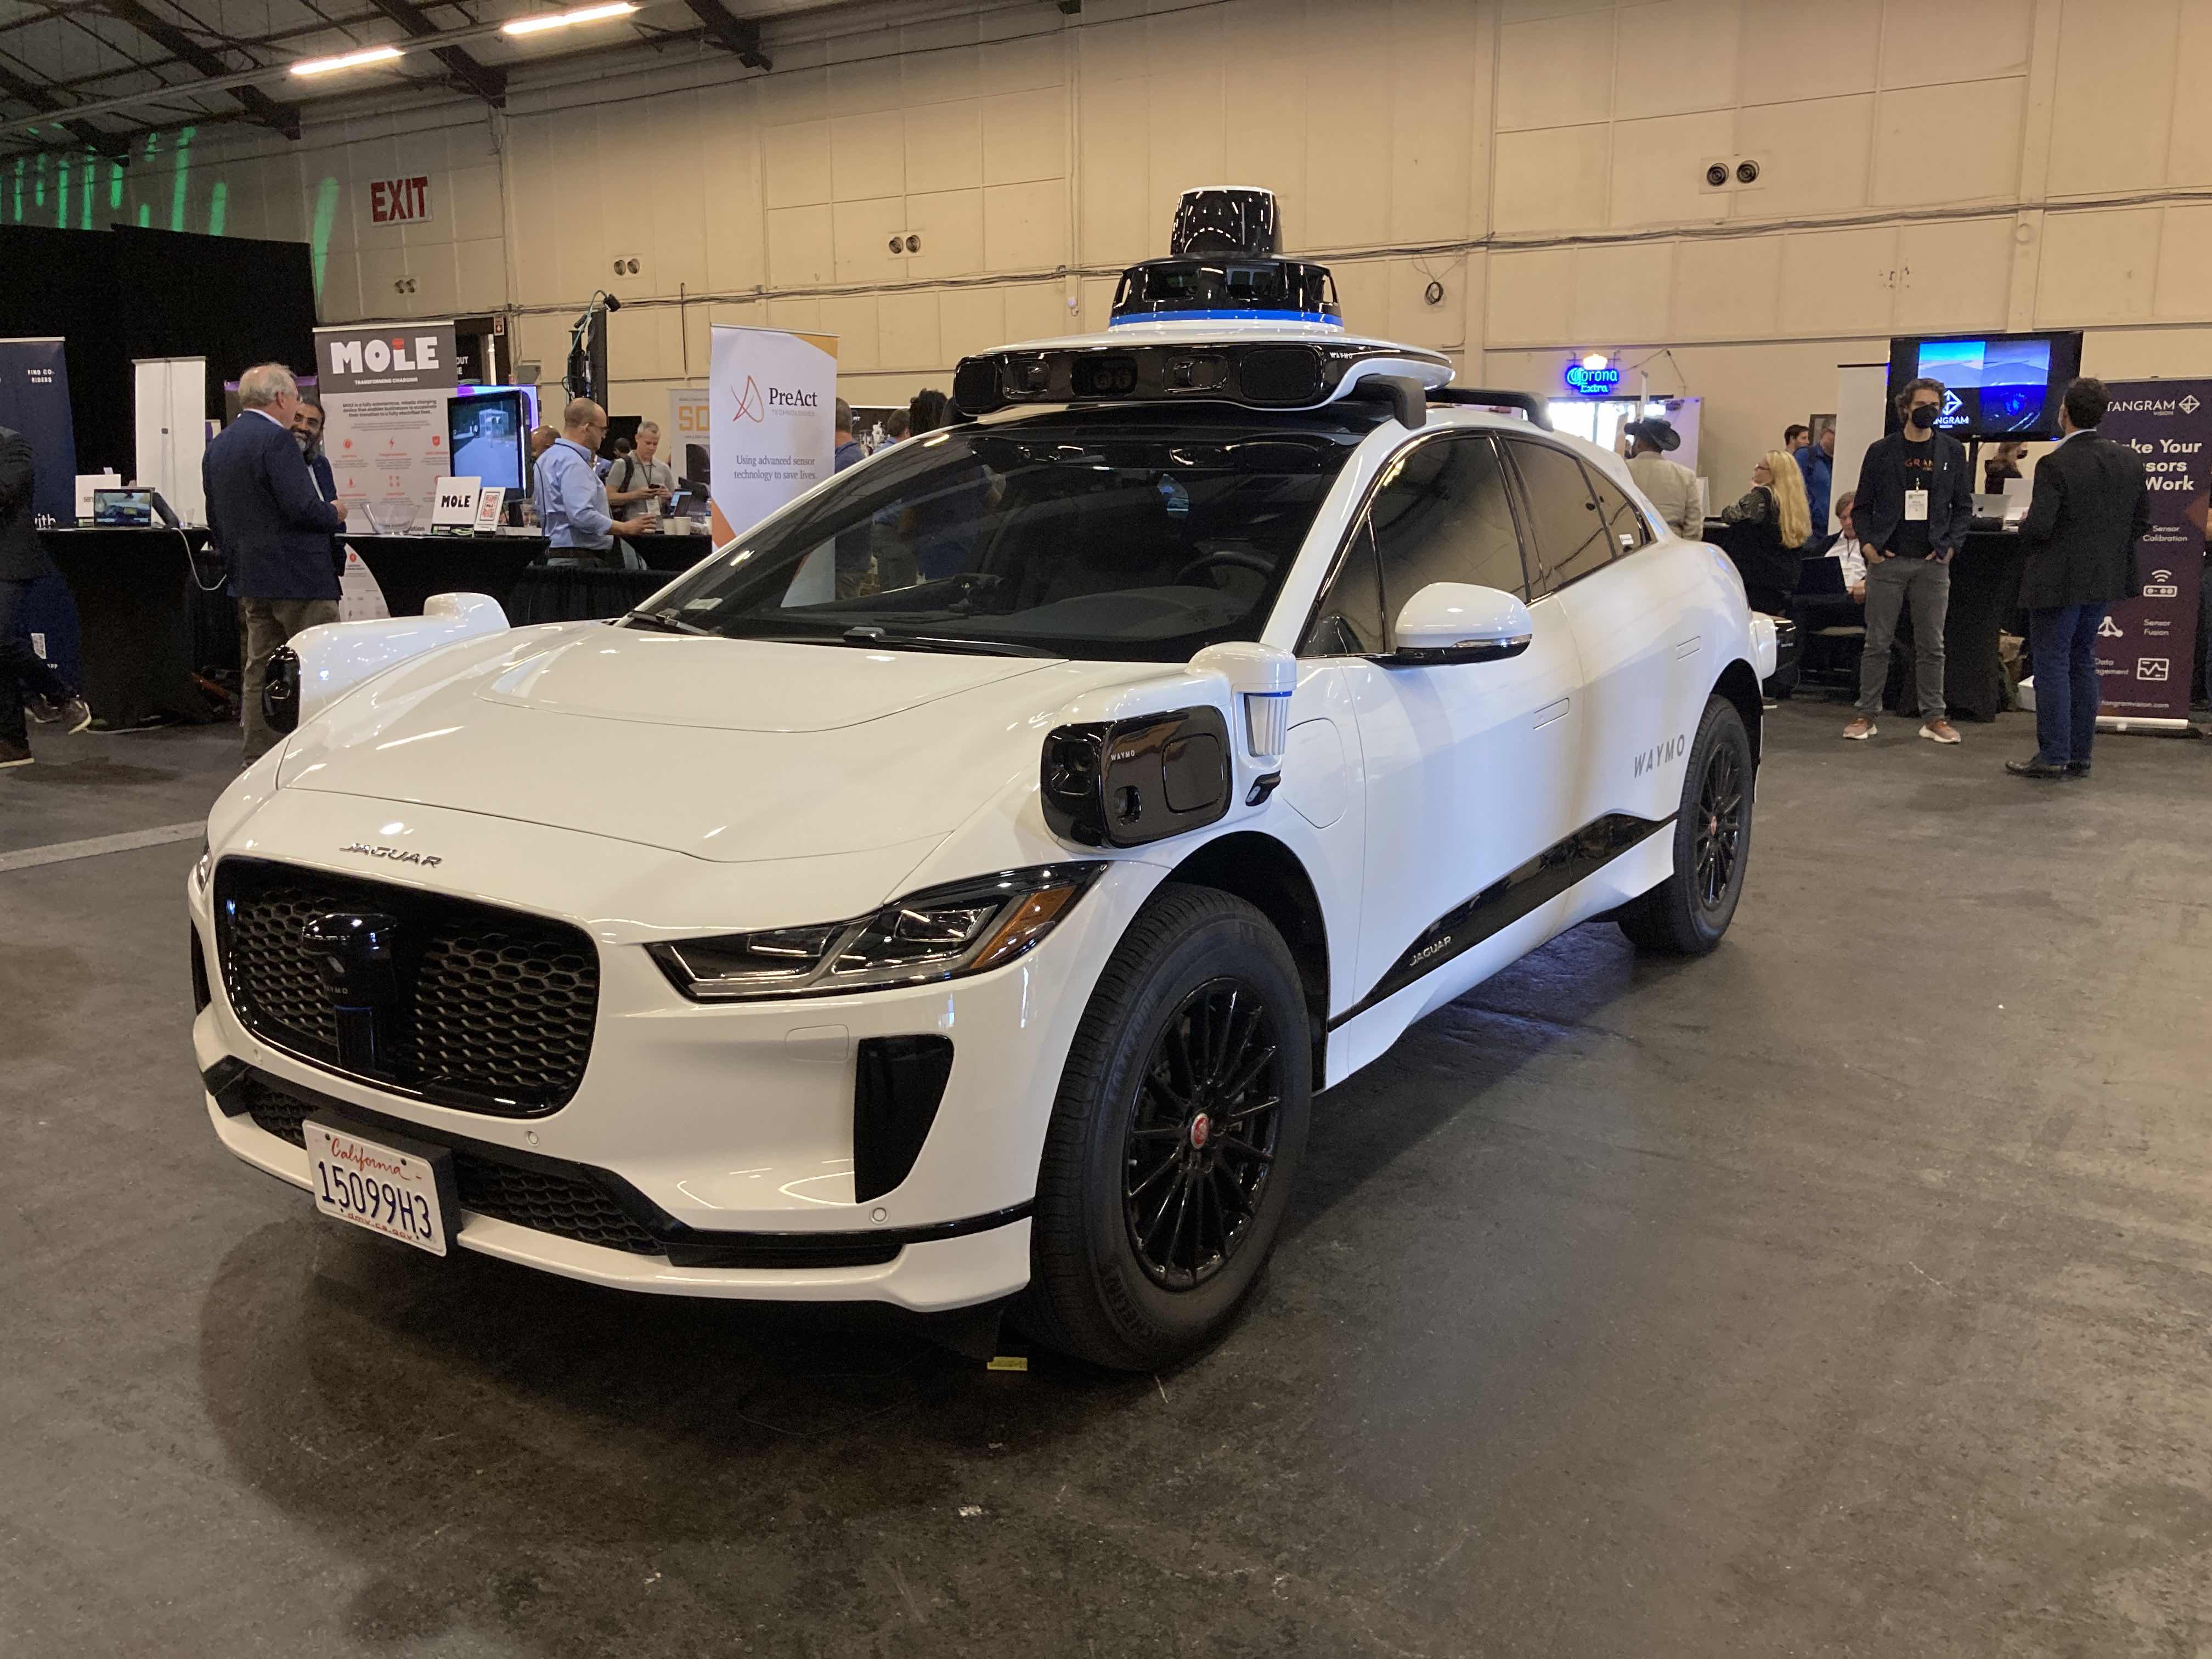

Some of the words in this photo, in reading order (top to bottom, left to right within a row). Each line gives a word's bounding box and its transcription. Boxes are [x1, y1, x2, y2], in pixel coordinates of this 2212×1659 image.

[371, 176, 428, 222] EXIT
[330, 337, 439, 374] MOLE
[1567, 367, 1618, 386] Corona
[1580, 384, 1608, 393] Extra
[769, 387, 817, 407] PreAct
[772, 409, 816, 417] TECHNOLOGIES
[2117, 438, 2153, 454] ke
[2160, 439, 2202, 454] Your
[737, 455, 757, 466] Using
[758, 455, 791, 466] advanced
[2145, 461, 2187, 472] sors
[734, 470, 773, 482] technology
[800, 470, 817, 480] lives.
[2145, 475, 2194, 491] Work
[441, 495, 471, 508] MOLE
[35, 513, 56, 529] ith
[2142, 534, 2188, 542] Calibration
[2144, 628, 2169, 636] Fusion
[1110, 749, 1135, 761] WAYMO
[1634, 734, 1685, 778] WAYMO
[339, 843, 443, 868] JAGUAR
[1409, 935, 1452, 967] JAGUAR
[331, 1138, 411, 1181] California
[318, 1161, 432, 1239] 15099H3
[347, 1212, 413, 1241] dmv.ca.gov
